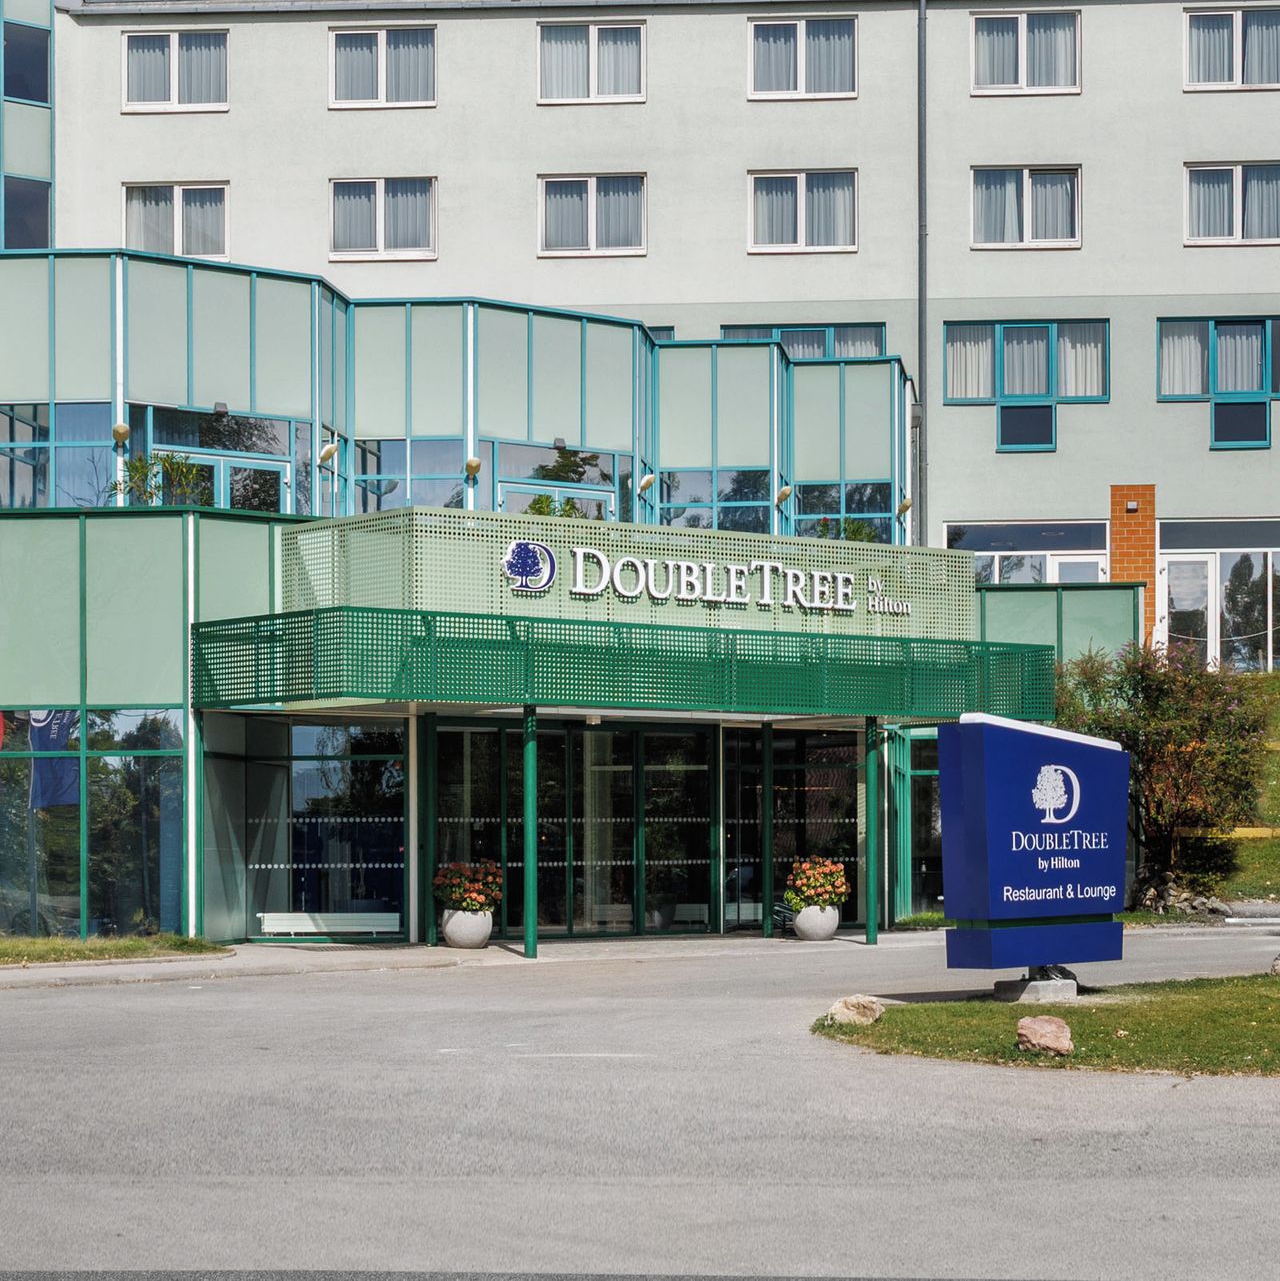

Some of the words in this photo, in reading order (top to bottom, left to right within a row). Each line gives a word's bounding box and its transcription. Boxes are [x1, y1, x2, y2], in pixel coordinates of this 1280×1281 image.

[868, 575, 885, 597] by
[868, 596, 911, 614] Hilton
[1038, 857, 1049, 873] by
[1050, 856, 1080, 869] Hilton
[1003, 885, 1064, 902] Restaurant
[1066, 883, 1075, 899] &
[1077, 883, 1117, 901] Lounge
